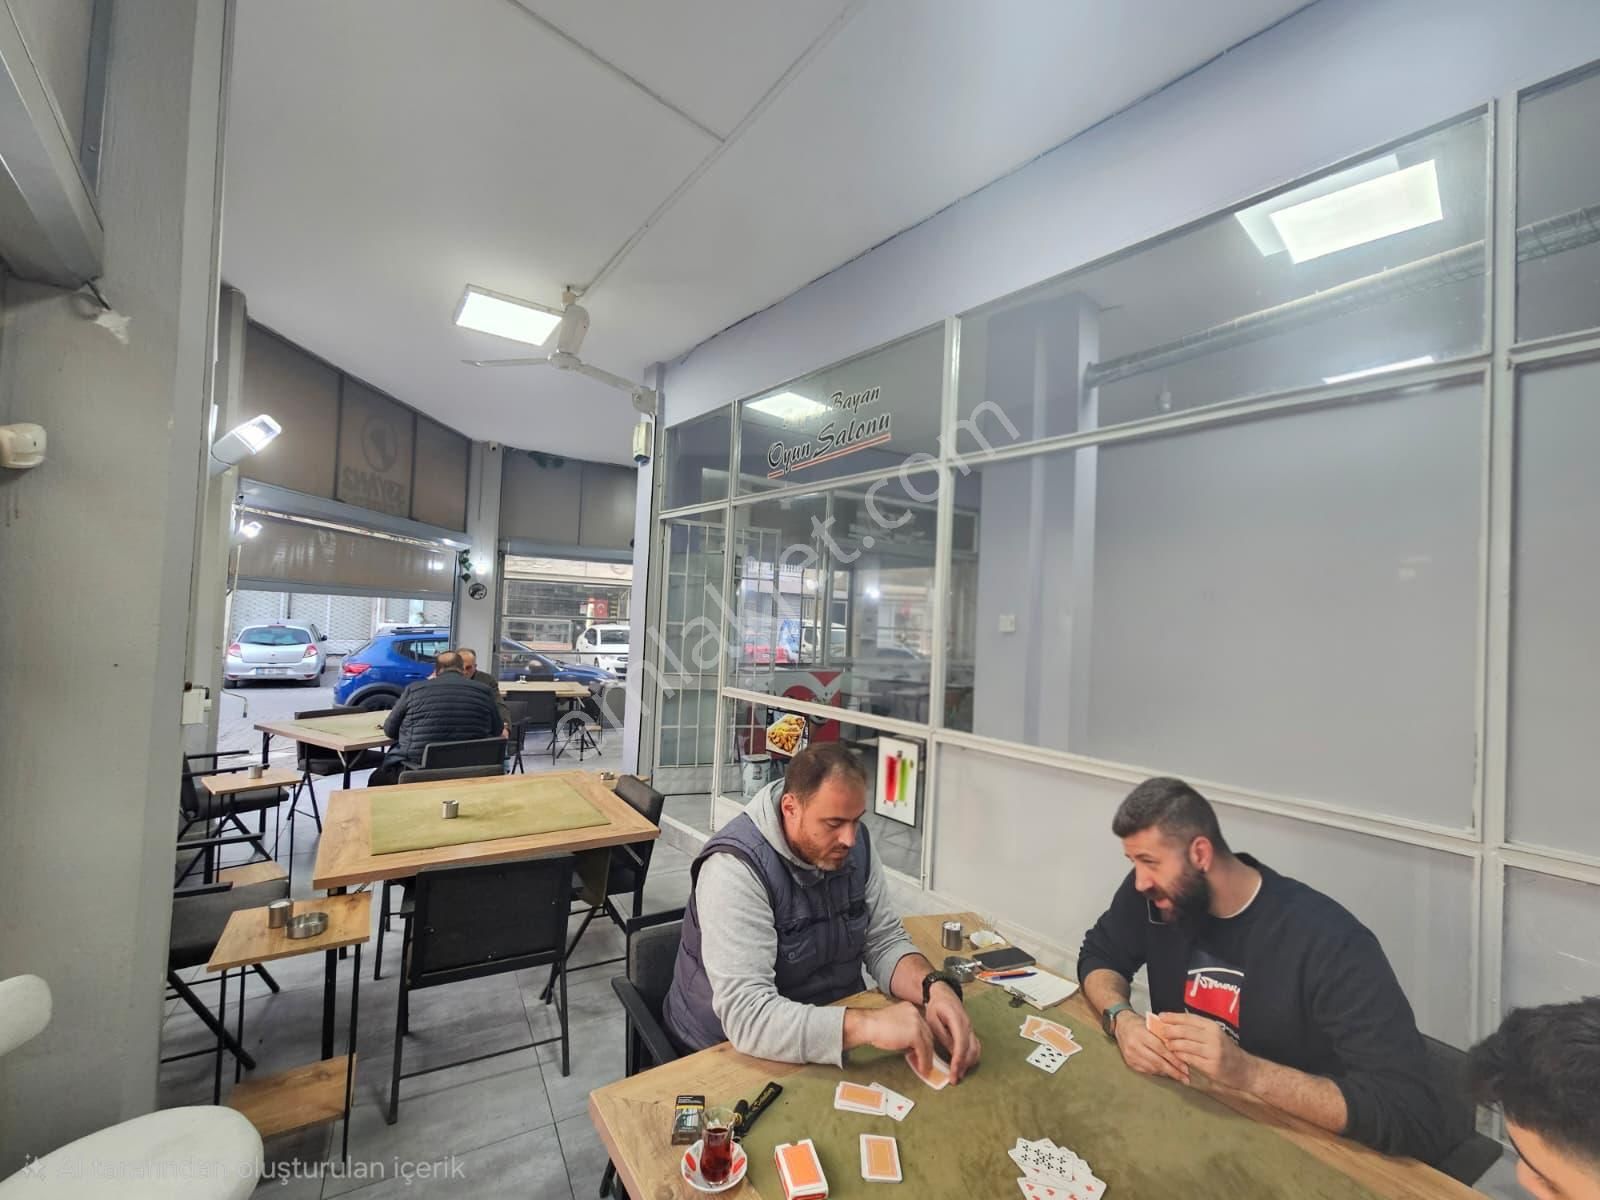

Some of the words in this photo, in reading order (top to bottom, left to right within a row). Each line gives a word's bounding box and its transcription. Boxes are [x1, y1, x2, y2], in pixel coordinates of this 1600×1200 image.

[831, 386, 880, 413] Bayan
[768, 441, 811, 473] Oyun
[813, 413, 891, 459] Salonu
